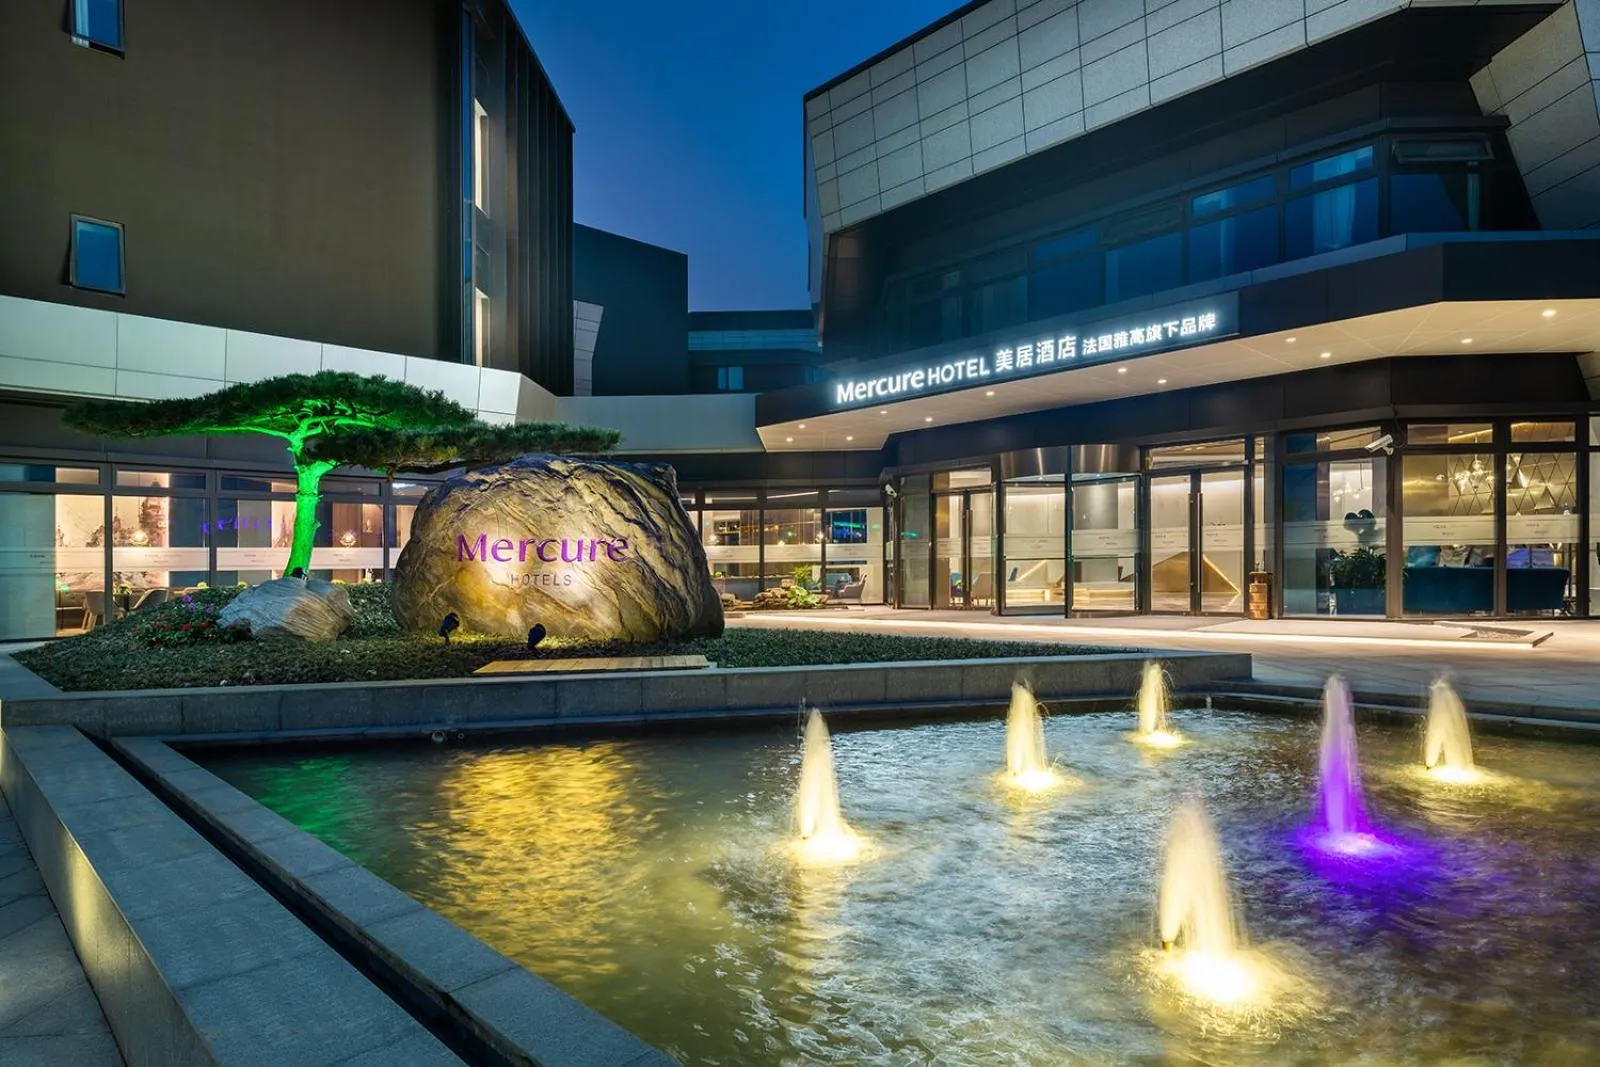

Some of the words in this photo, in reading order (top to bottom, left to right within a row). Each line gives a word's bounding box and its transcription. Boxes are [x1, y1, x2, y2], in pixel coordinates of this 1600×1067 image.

[836, 370, 924, 404] Mercure
[927, 357, 990, 386] HOTEL
[995, 335, 1077, 373] 美居酒店
[1082, 311, 1216, 356] 法国雅高旗下品牌
[456, 532, 629, 563] Mercure
[510, 573, 572, 586] HOTELS
